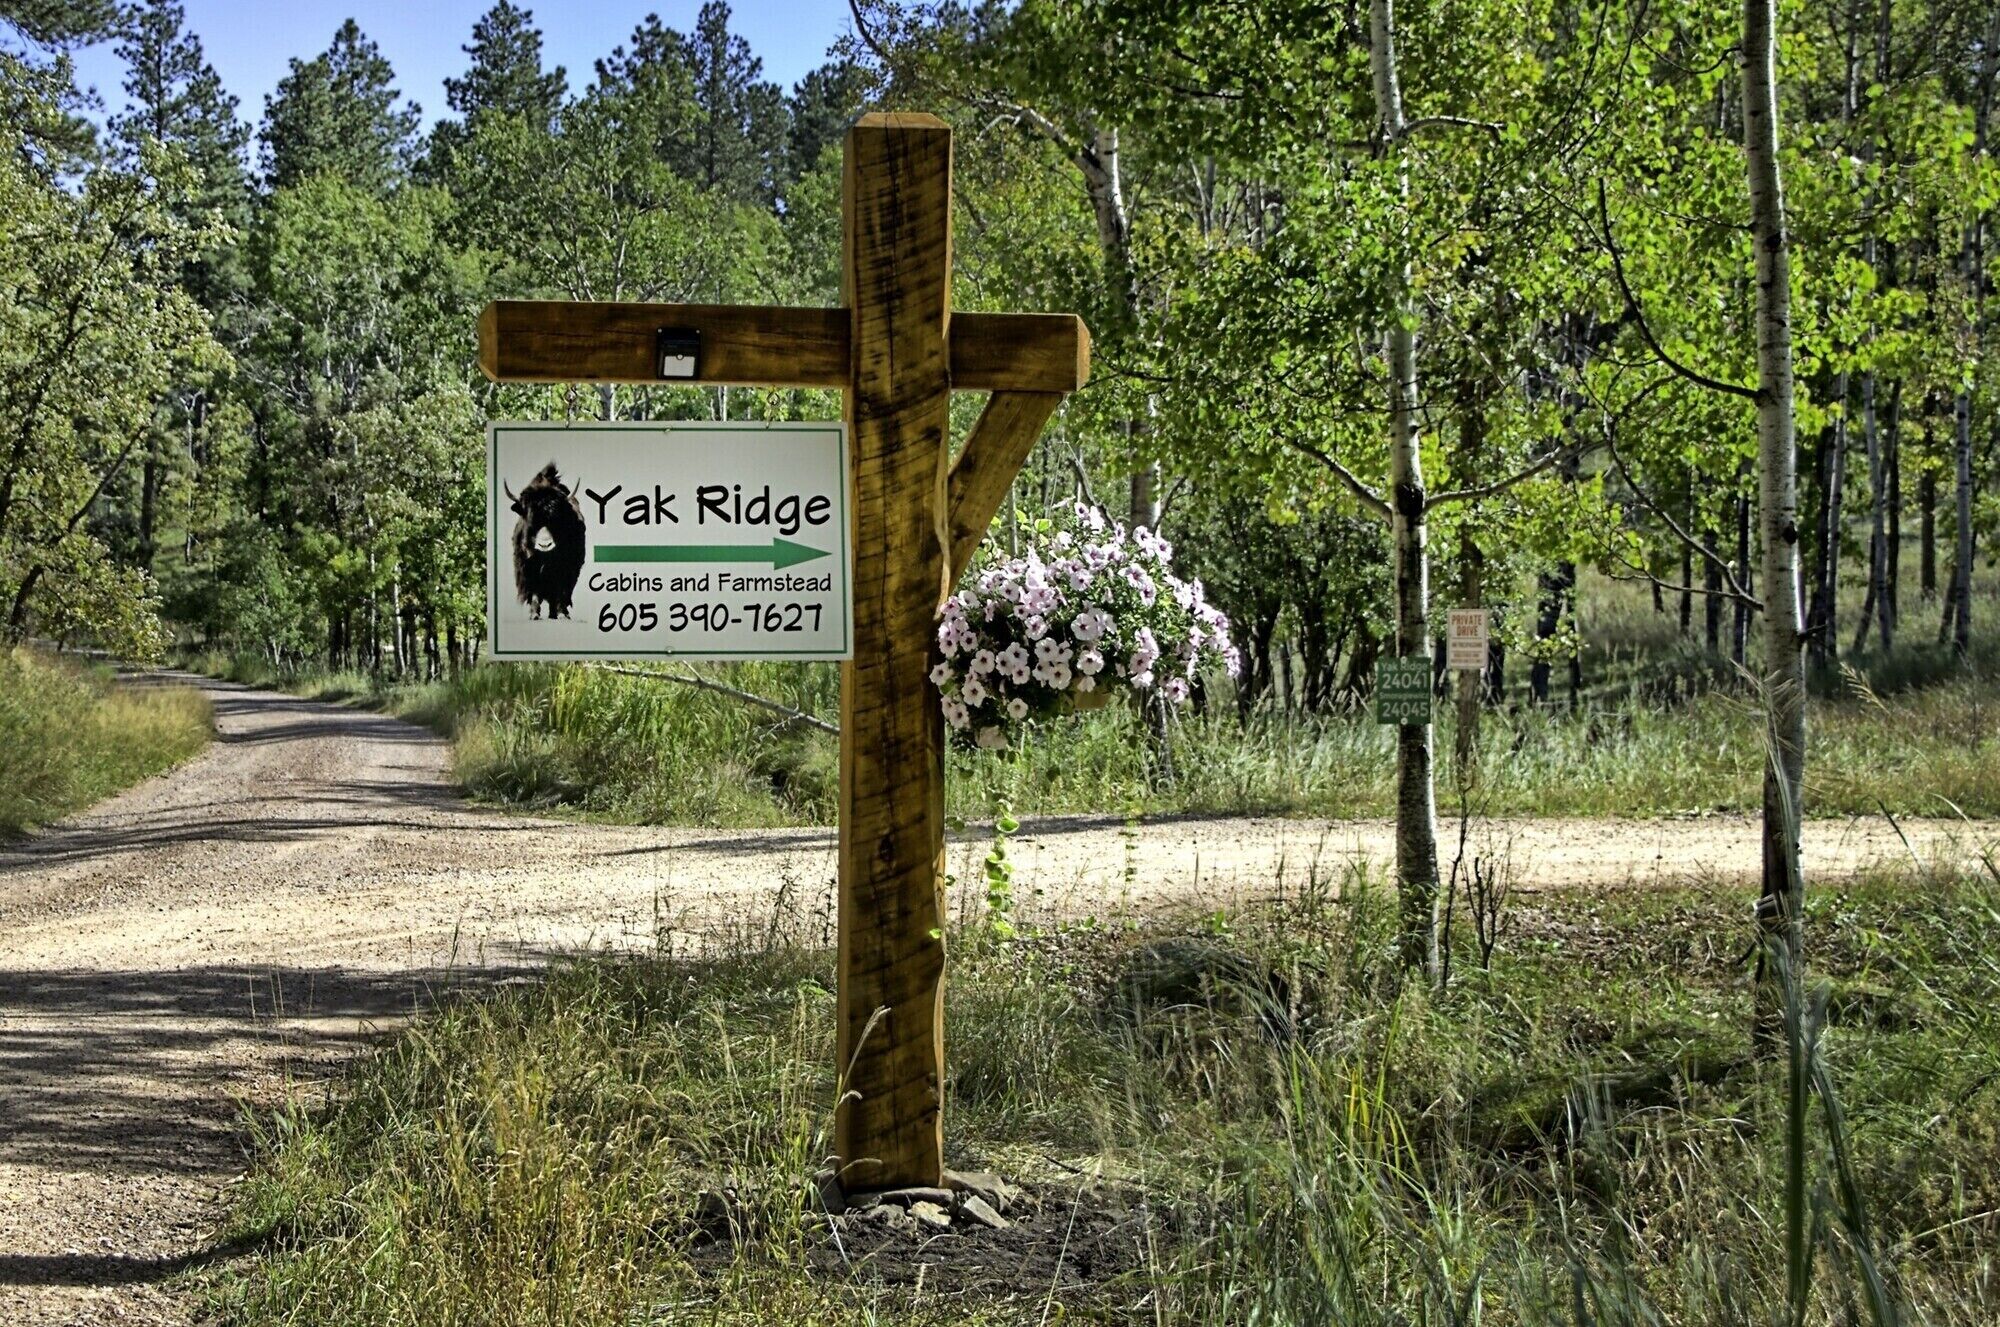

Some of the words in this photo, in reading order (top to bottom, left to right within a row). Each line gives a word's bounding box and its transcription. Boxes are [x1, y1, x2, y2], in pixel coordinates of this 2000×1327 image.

[585, 484, 679, 525] Yak
[696, 484, 832, 536] Ridge
[588, 572, 663, 592] Cabins
[670, 572, 710, 592] and
[718, 572, 832, 592] Farmstead
[598, 603, 659, 633] 605
[669, 603, 823, 633] 390-7627
[1451, 614, 1482, 626] PRIVATE
[1456, 625, 1479, 637] DRIVE
[1381, 662, 1398, 671] Yak
[1400, 661, 1429, 673] Ridge
[1382, 673, 1429, 689] 24041
[1382, 702, 1429, 718] 24045
